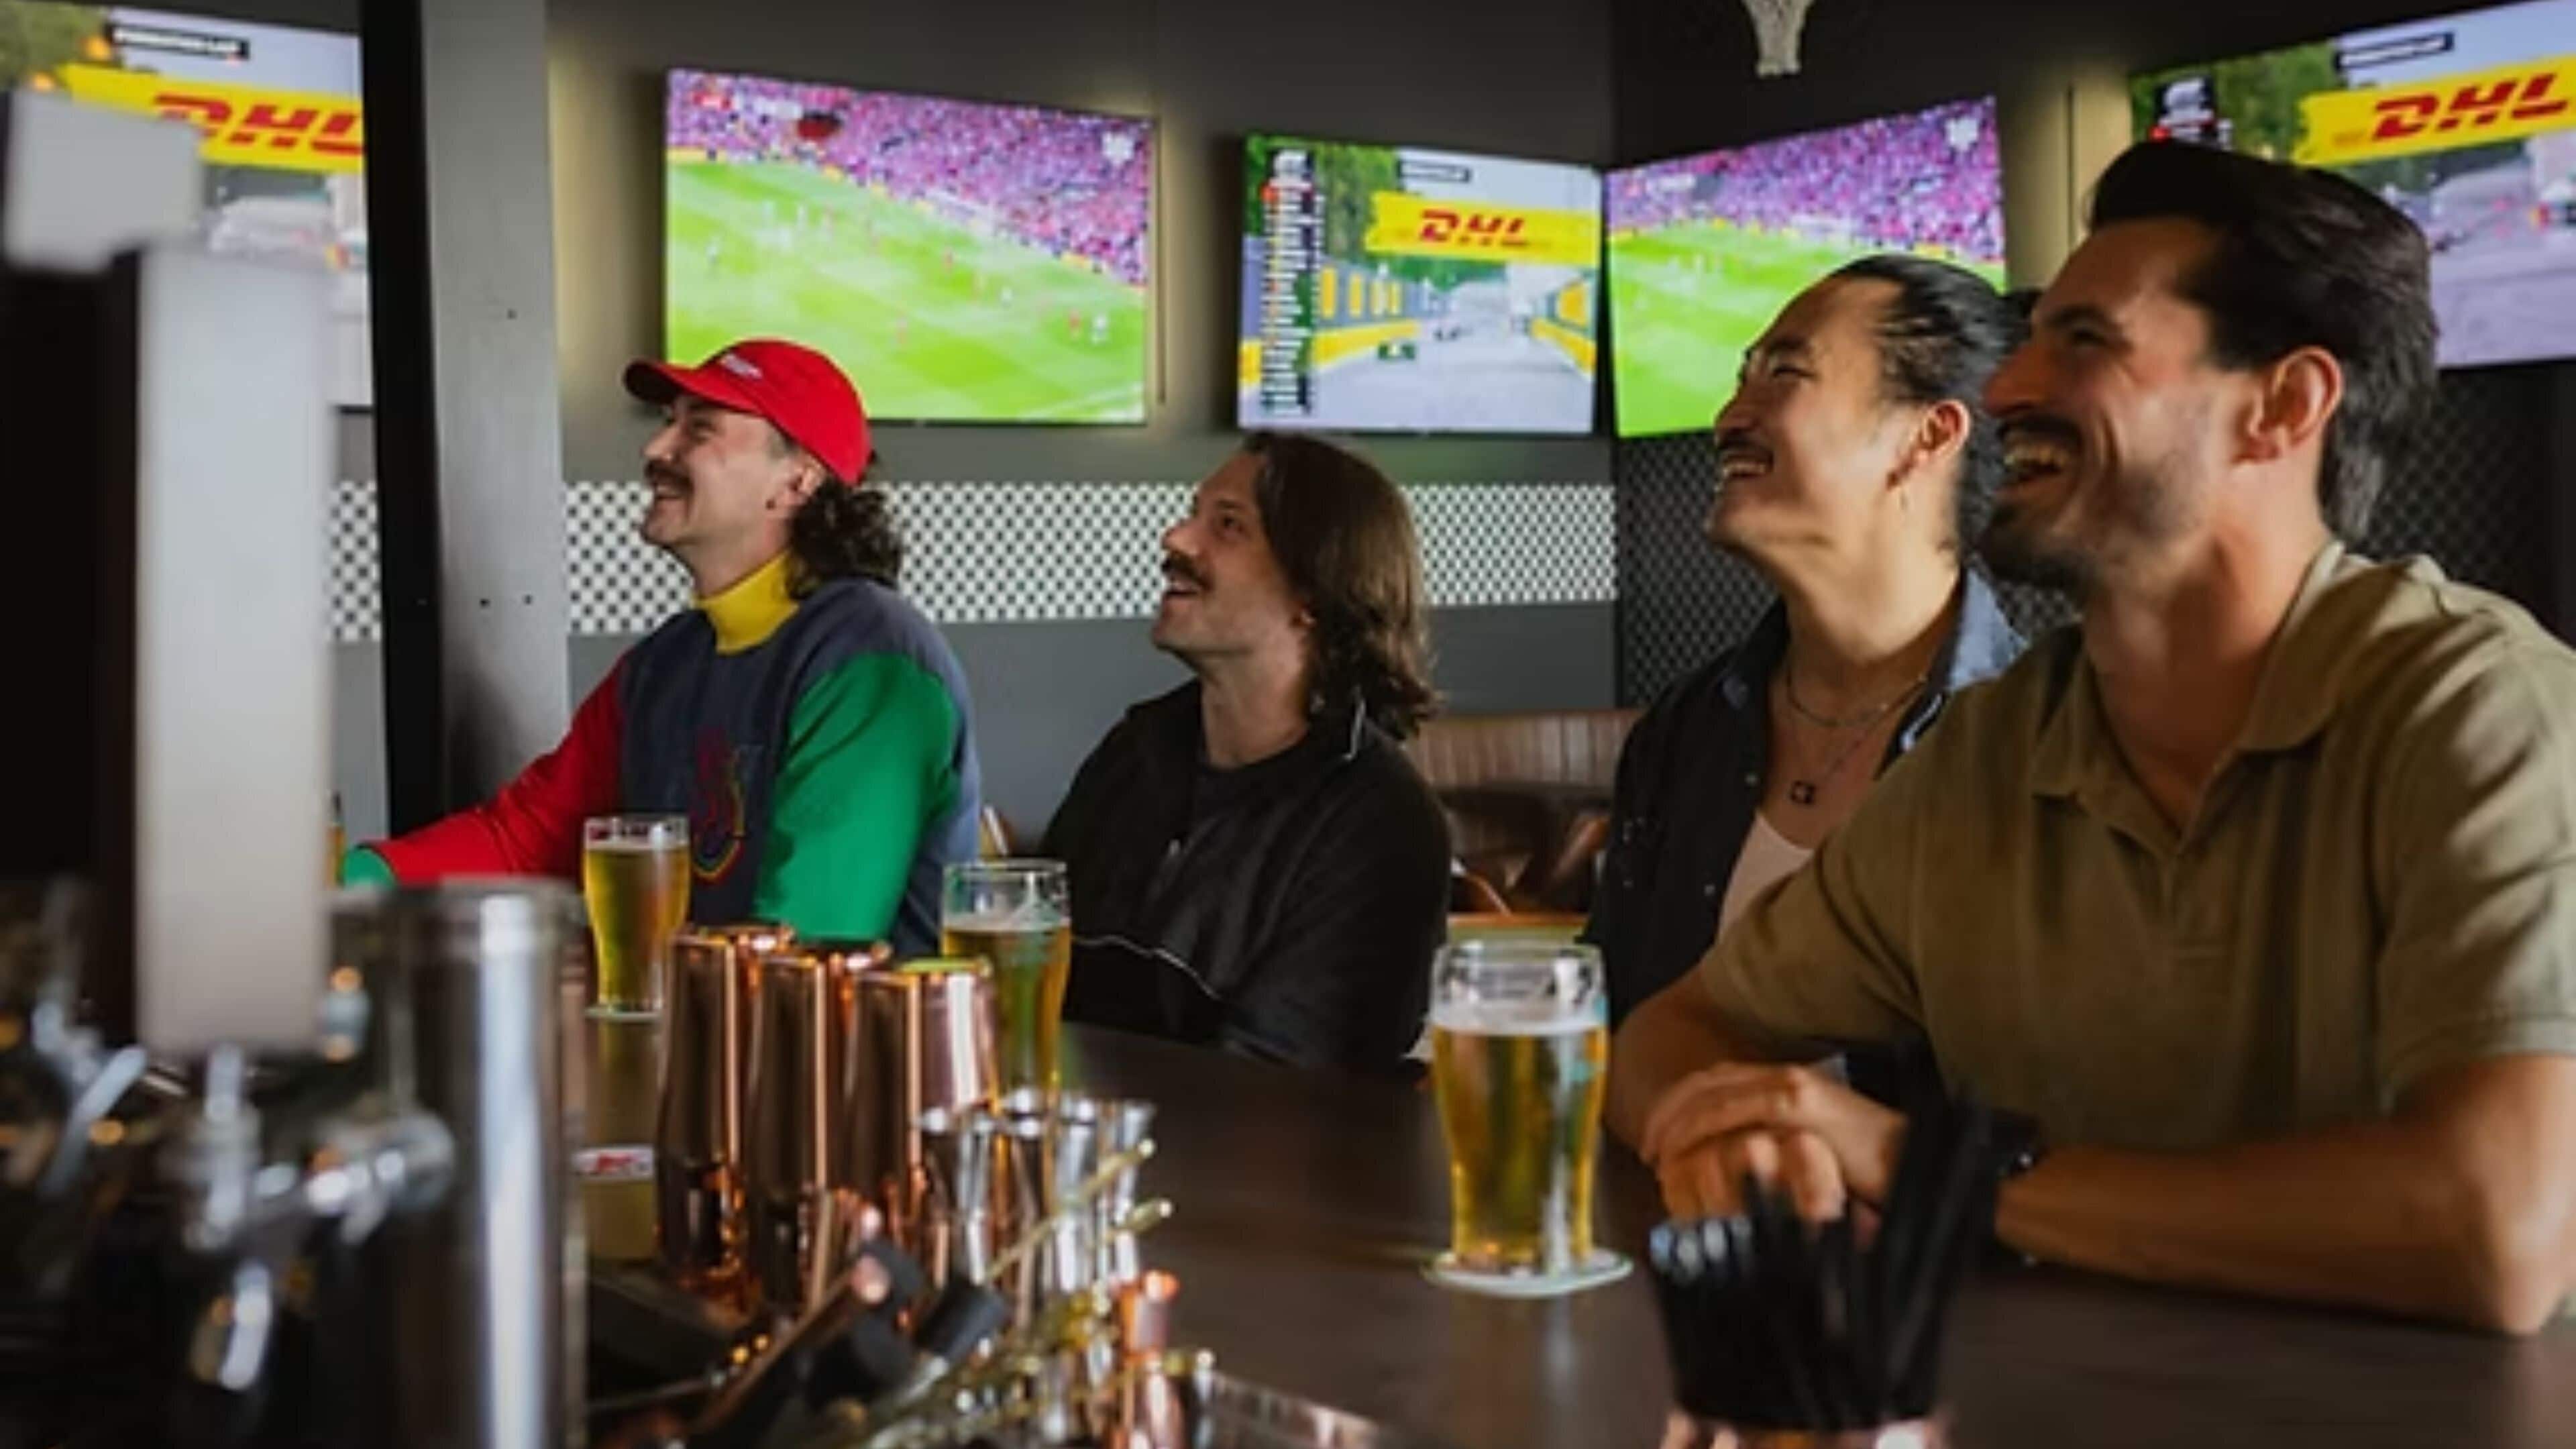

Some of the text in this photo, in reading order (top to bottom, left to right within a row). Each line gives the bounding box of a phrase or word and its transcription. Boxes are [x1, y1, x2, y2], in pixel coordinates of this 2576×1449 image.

[154, 93, 364, 156] DHL
[2373, 73, 2569, 140] DHL
[1421, 209, 1529, 248] DHL
